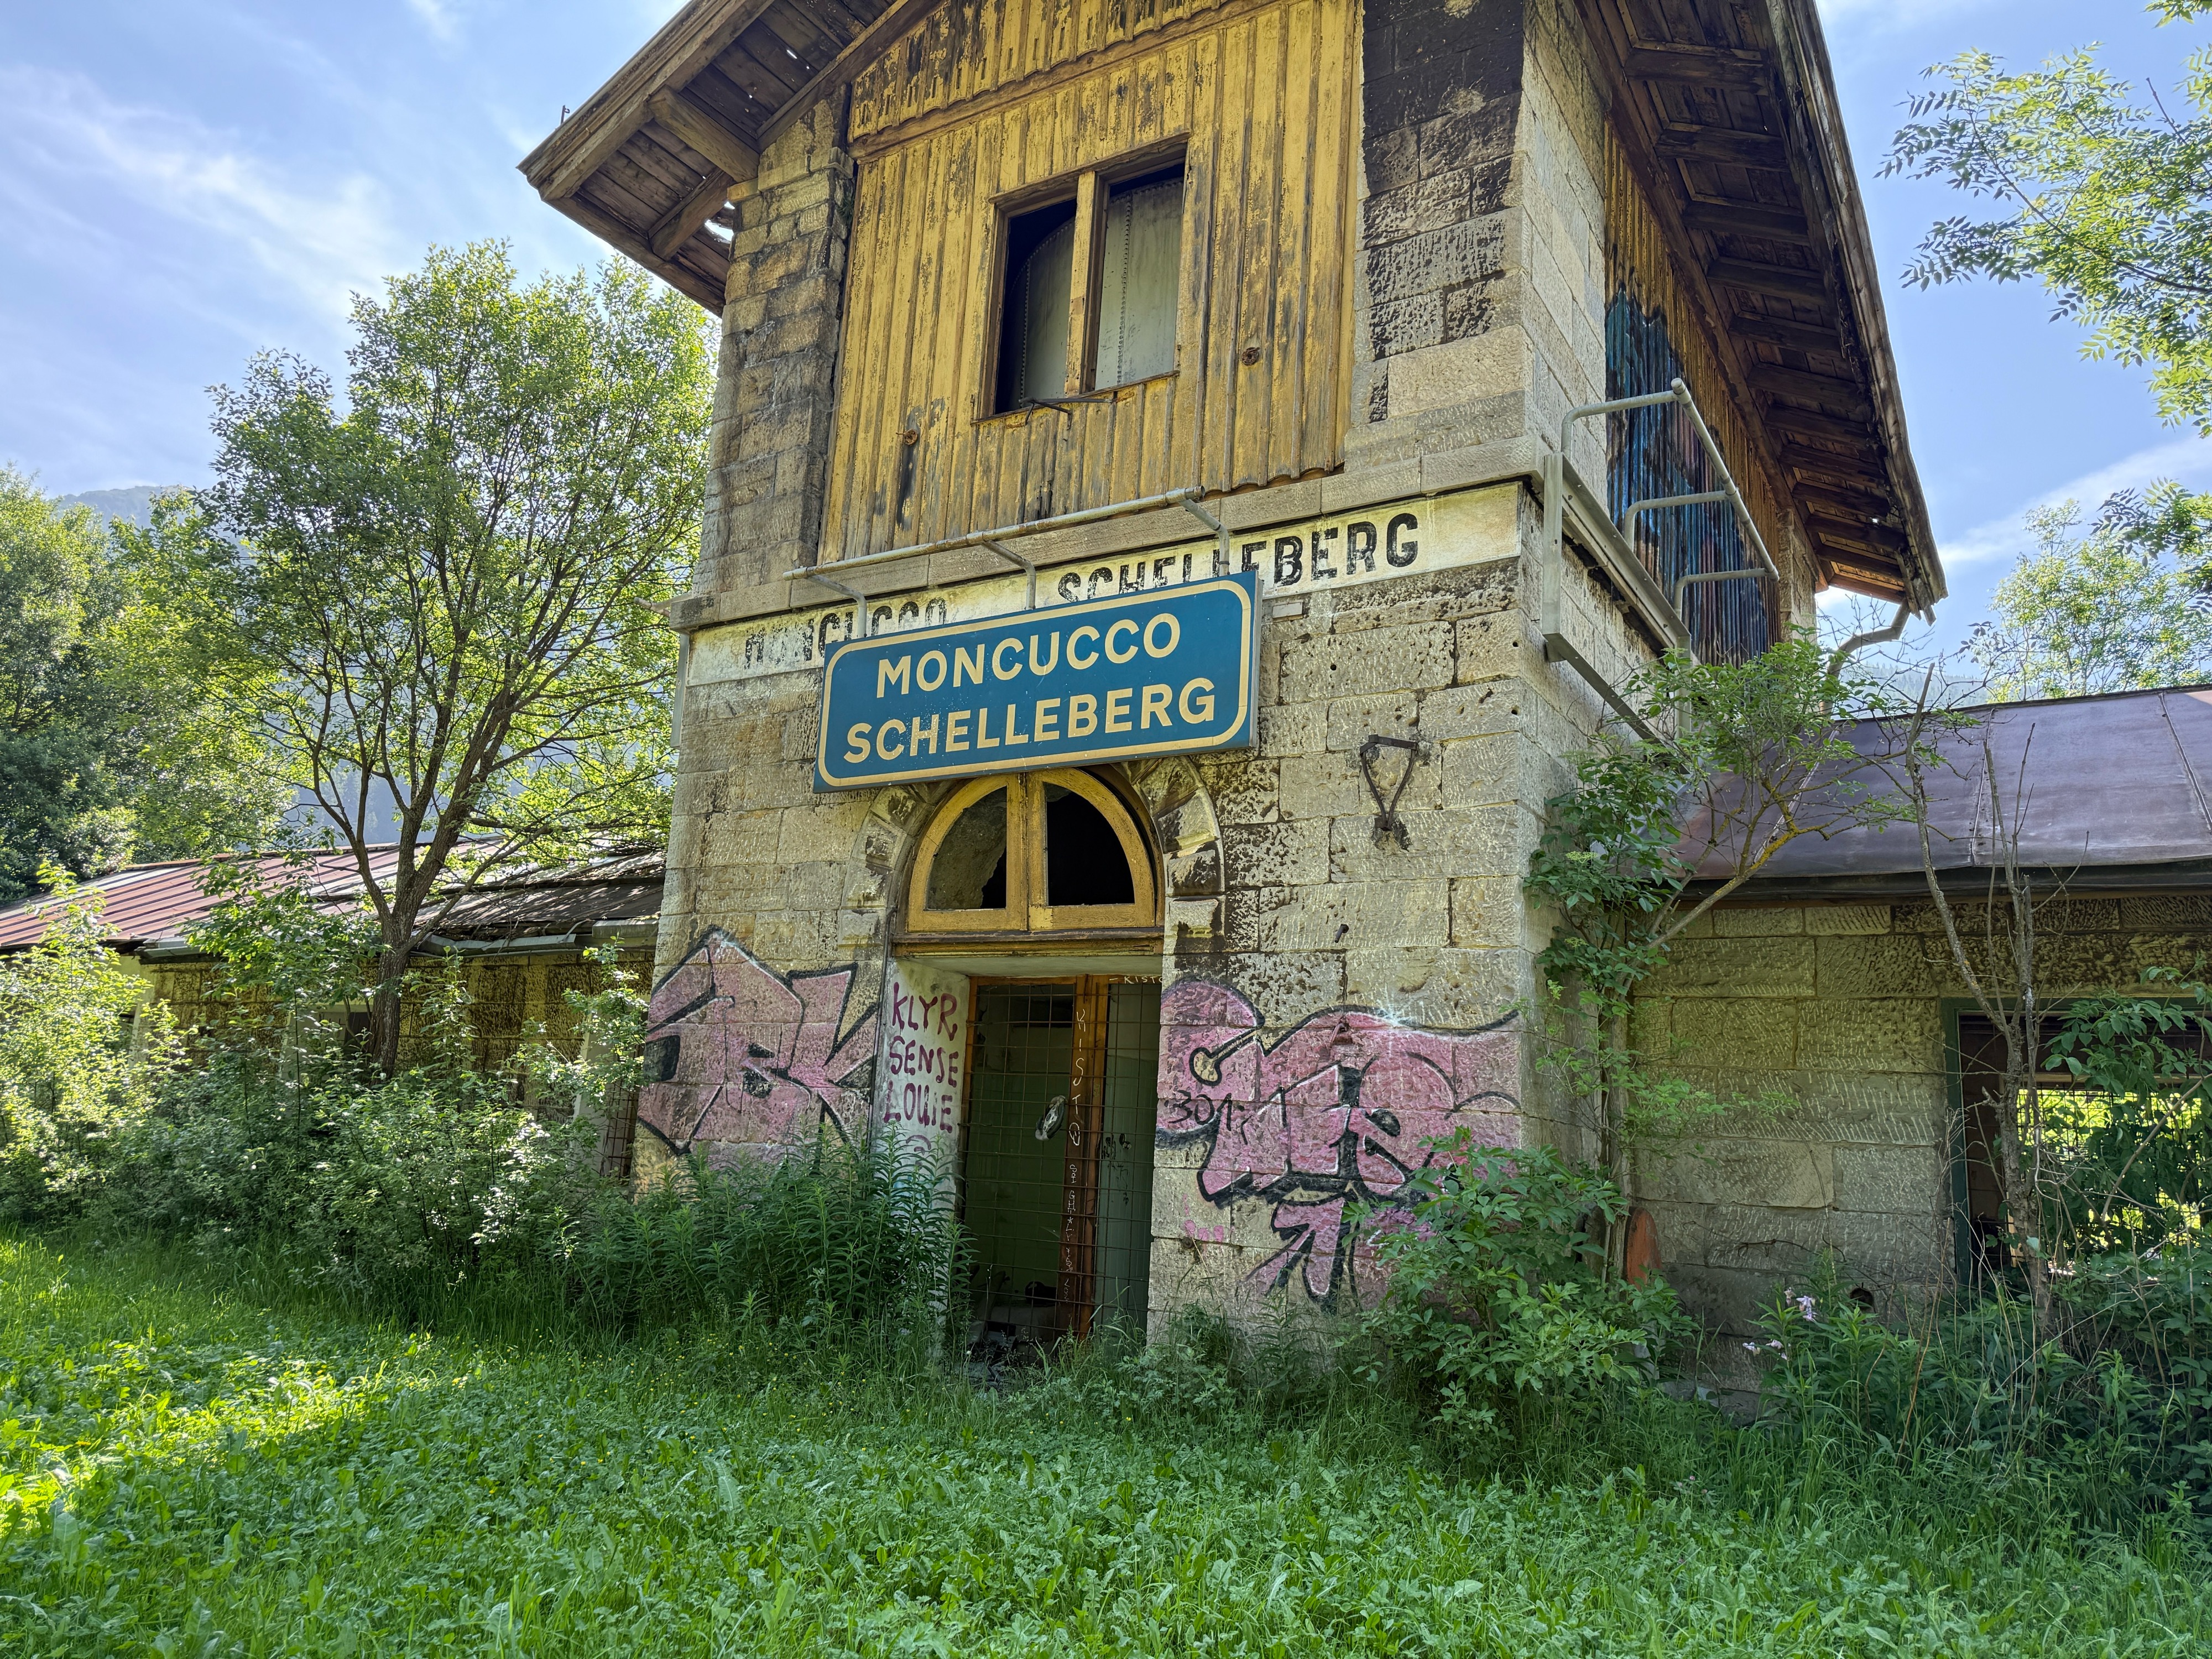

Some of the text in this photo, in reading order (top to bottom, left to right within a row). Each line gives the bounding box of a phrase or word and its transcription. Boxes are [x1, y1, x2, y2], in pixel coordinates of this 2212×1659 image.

[876, 612, 1181, 698] MONCUCCO
[843, 677, 1215, 763] SCHELLEBERG
[892, 982, 958, 1041] KLYR
[889, 1035, 959, 1088] SENSE
